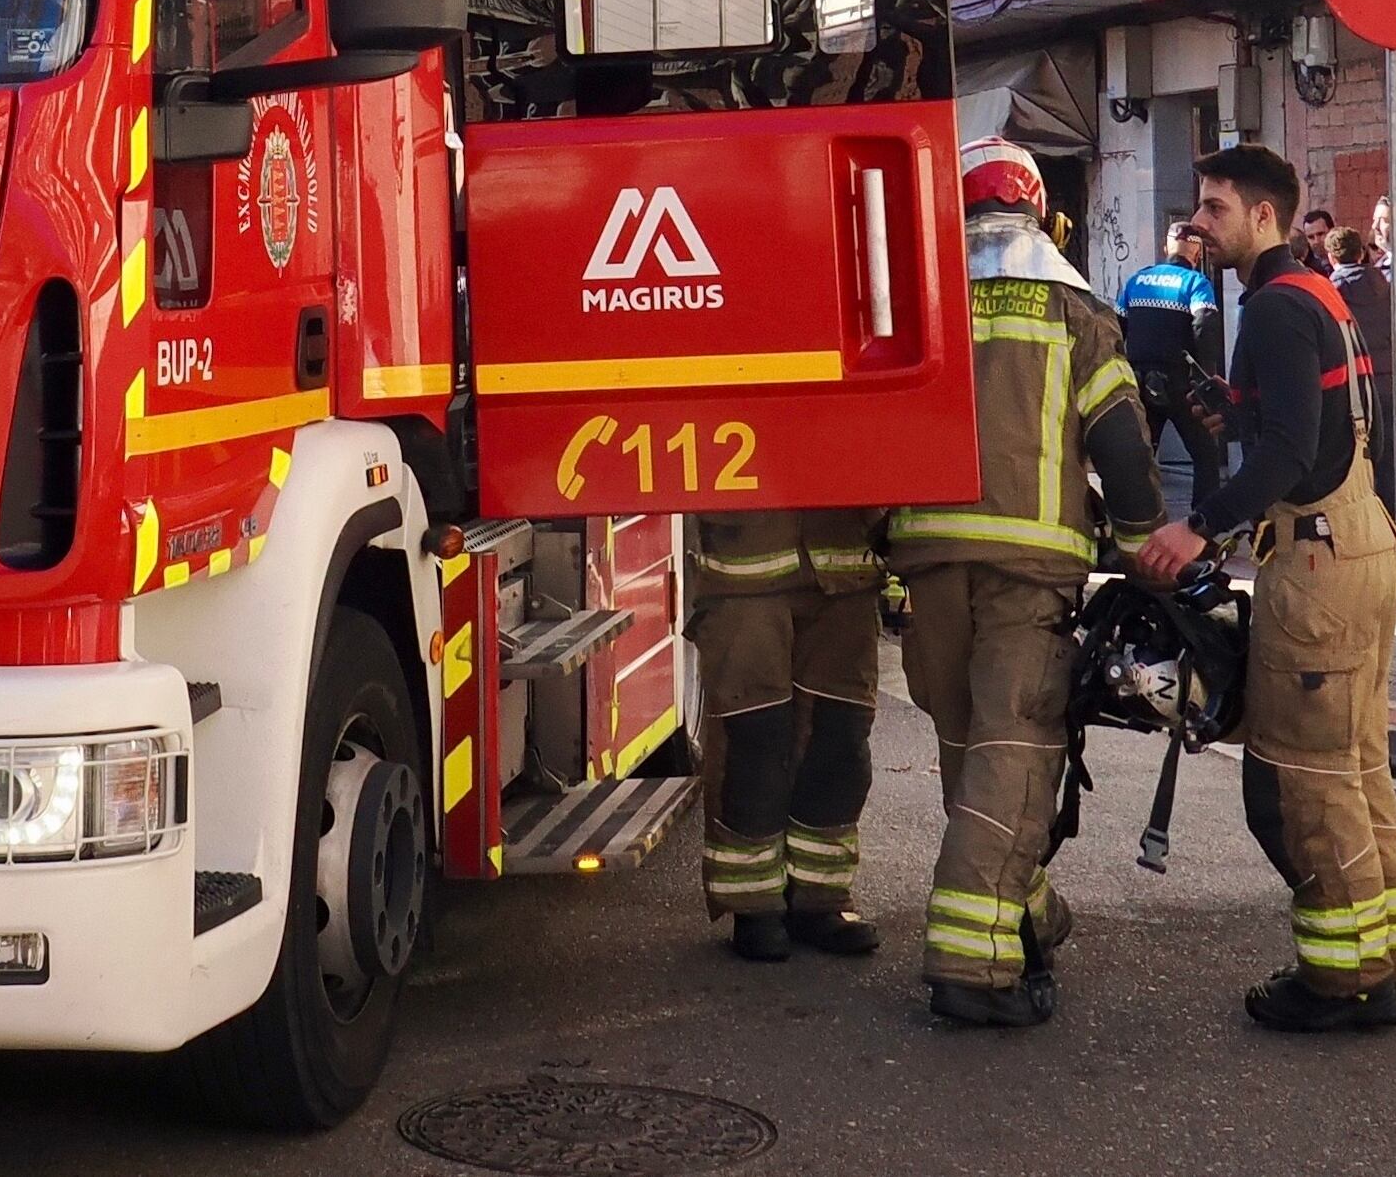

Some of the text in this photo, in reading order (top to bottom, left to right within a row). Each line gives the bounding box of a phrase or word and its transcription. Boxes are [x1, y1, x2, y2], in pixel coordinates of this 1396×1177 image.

[582, 284, 724, 312] MAGIRUS
[157, 337, 213, 386] BUP-2
[622, 421, 759, 493] 112
